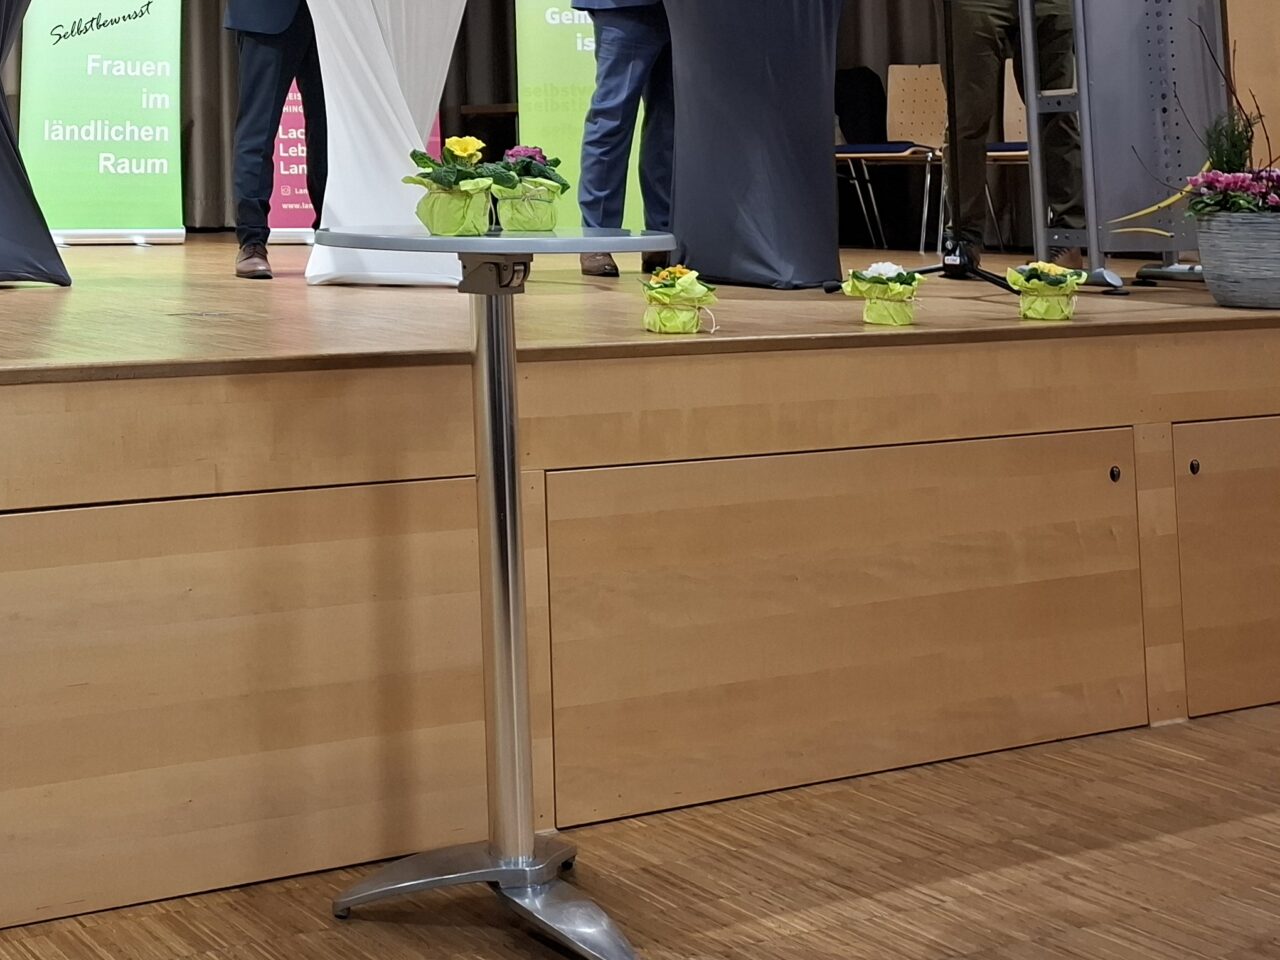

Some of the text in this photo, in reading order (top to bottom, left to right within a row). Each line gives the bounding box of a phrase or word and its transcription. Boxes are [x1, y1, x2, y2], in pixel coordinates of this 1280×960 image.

[50, 1, 153, 46] Selbstbewusst
[86, 53, 170, 77] Frauen
[141, 88, 170, 109] im
[43, 119, 169, 141] ländlichen
[98, 152, 168, 174] Raum
